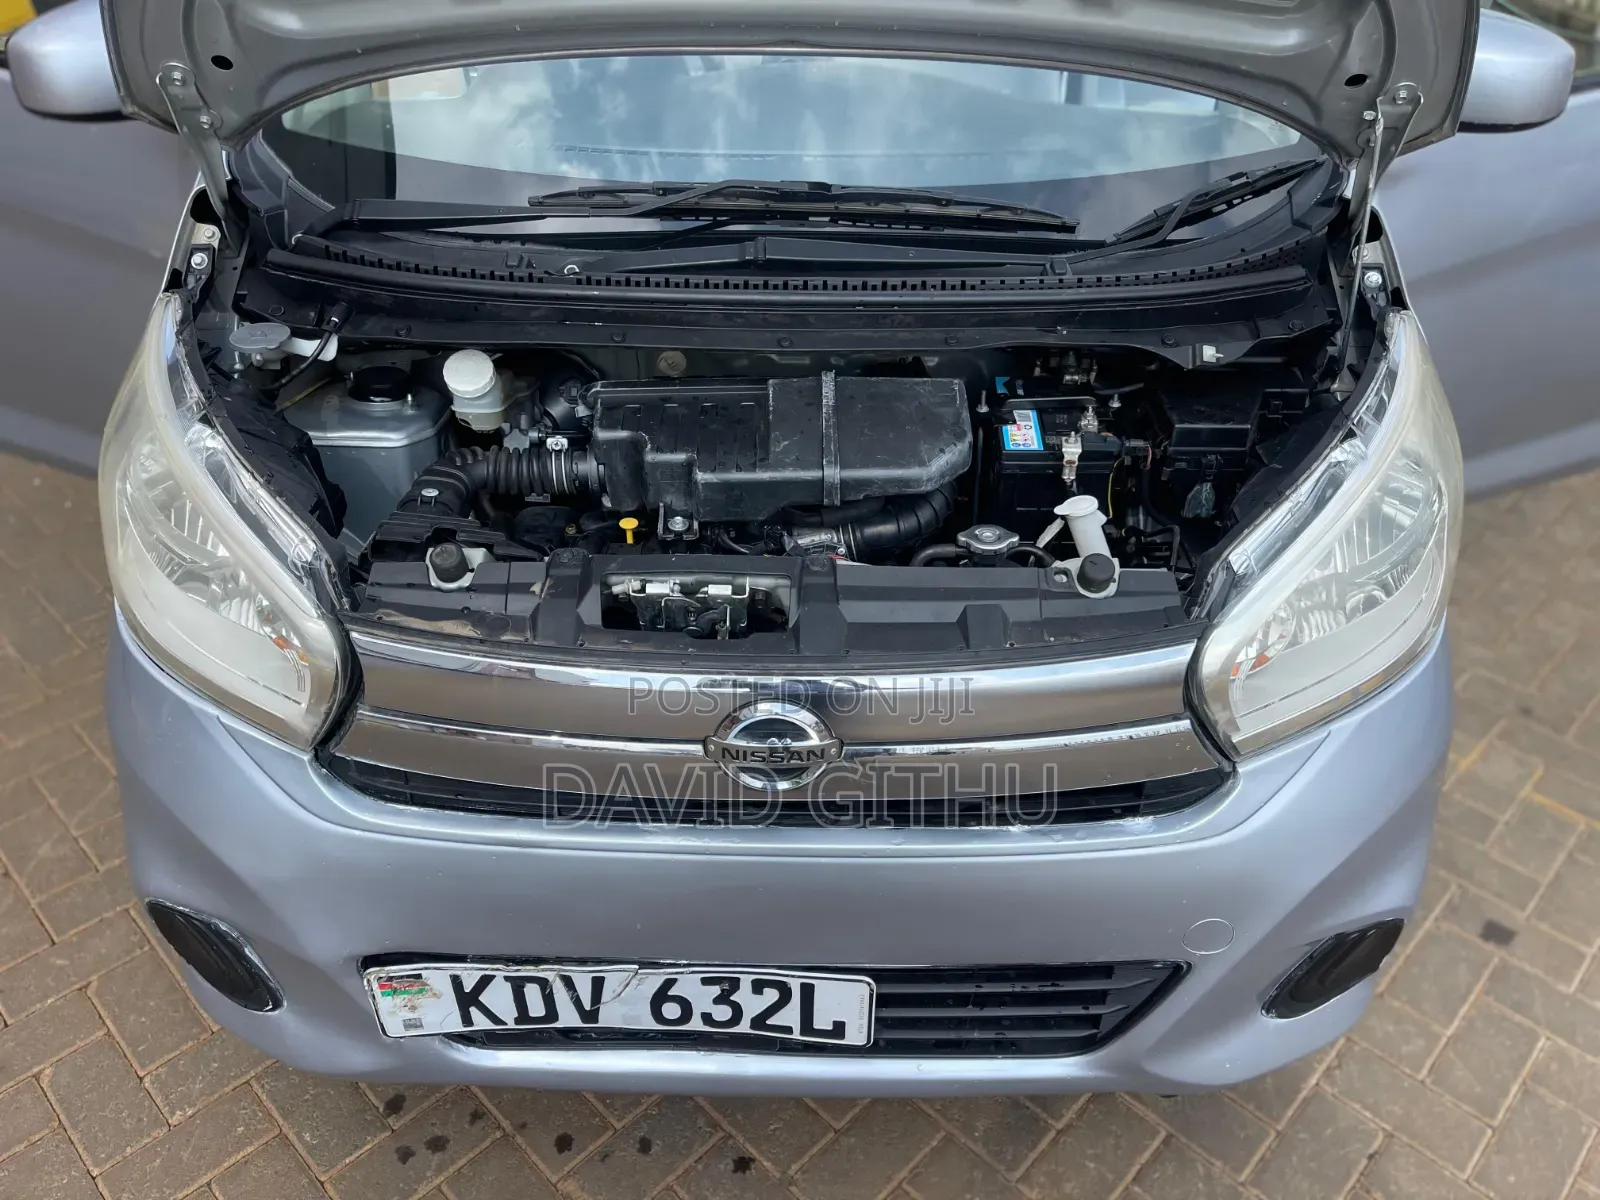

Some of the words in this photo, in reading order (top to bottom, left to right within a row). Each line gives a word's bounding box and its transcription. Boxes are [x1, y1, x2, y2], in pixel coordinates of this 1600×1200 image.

[721, 747, 826, 763] NISSAN
[448, 973, 607, 1027] KDV
[649, 977, 846, 1041] 632L
